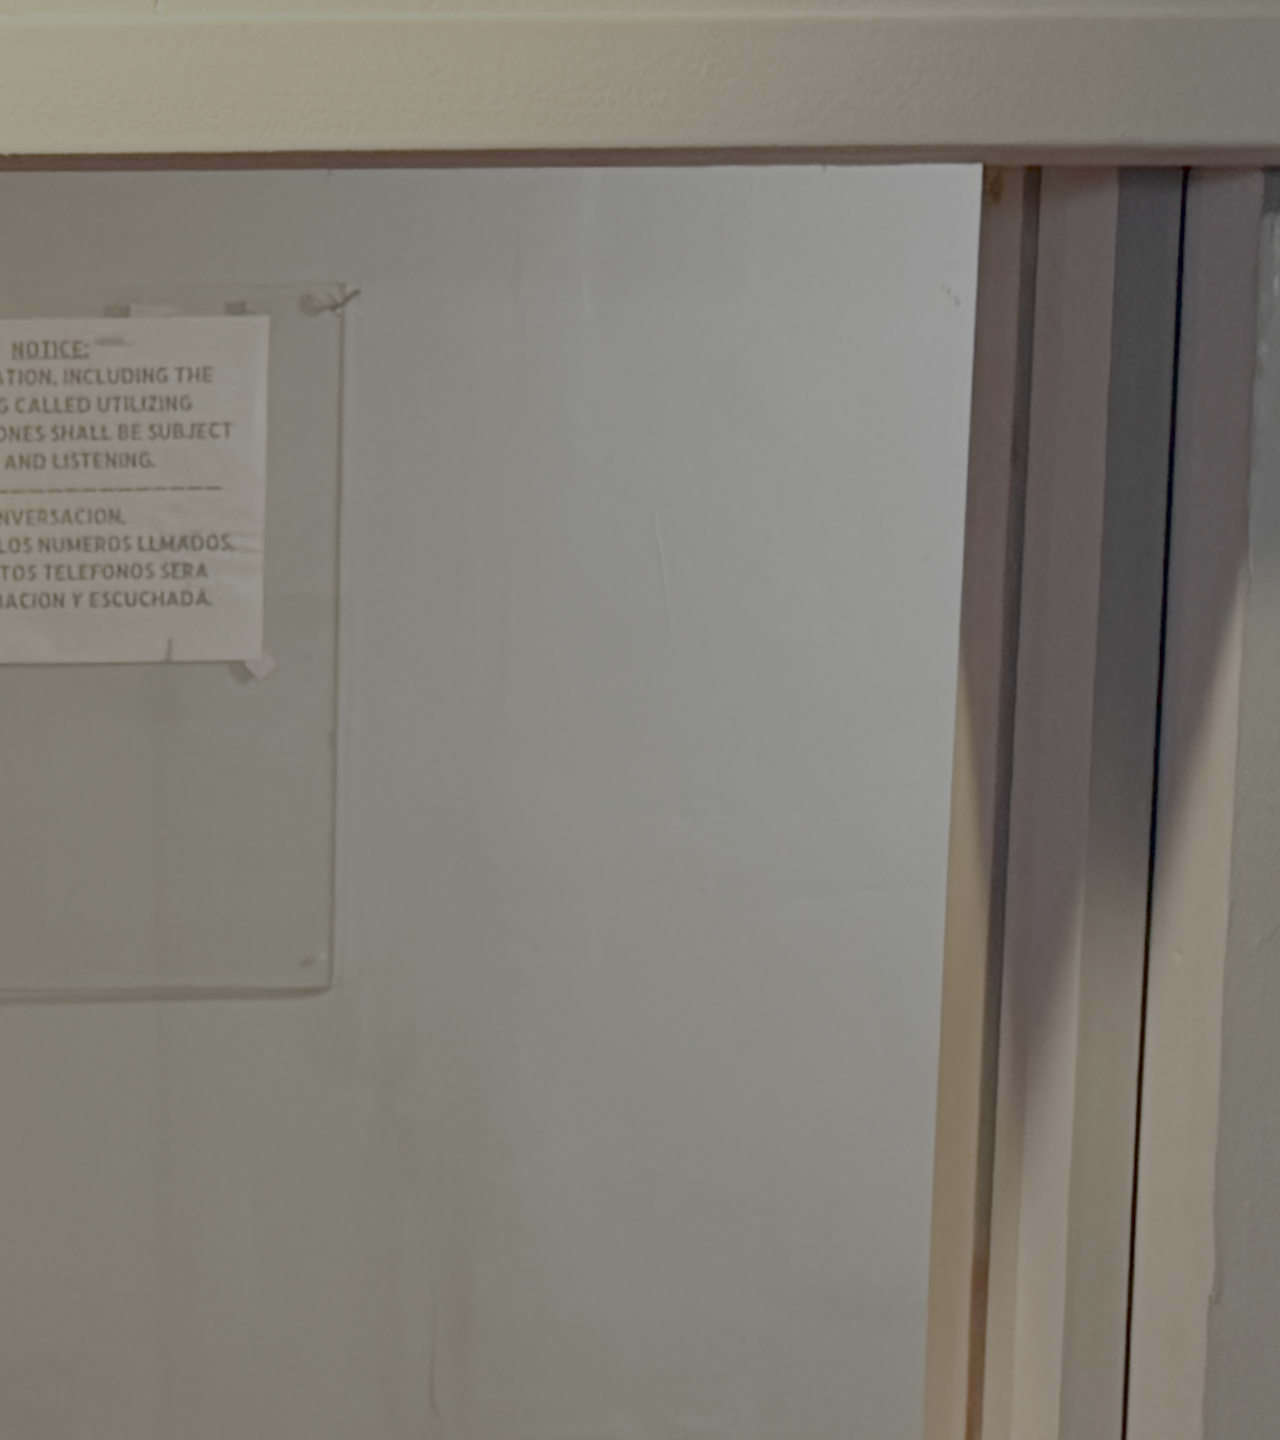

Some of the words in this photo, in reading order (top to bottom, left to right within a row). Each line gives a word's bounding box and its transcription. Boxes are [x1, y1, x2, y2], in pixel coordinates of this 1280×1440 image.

[11, 340, 90, 360] NOTICE:
[64, 367, 169, 385] INCLUDING
[175, 366, 214, 383] THE
[15, 396, 90, 414] CALLED
[97, 395, 192, 413] UTILIZING
[51, 424, 112, 442] SHALL
[118, 423, 142, 441] BE
[148, 422, 232, 440] SUBJECT
[4, 453, 46, 470] AND
[52, 452, 155, 469] LISTENING.
[39, 535, 132, 554] NUMEROS
[43, 563, 155, 581] TELEFONOS
[160, 562, 209, 580] SERA
[72, 592, 83, 608] Y
